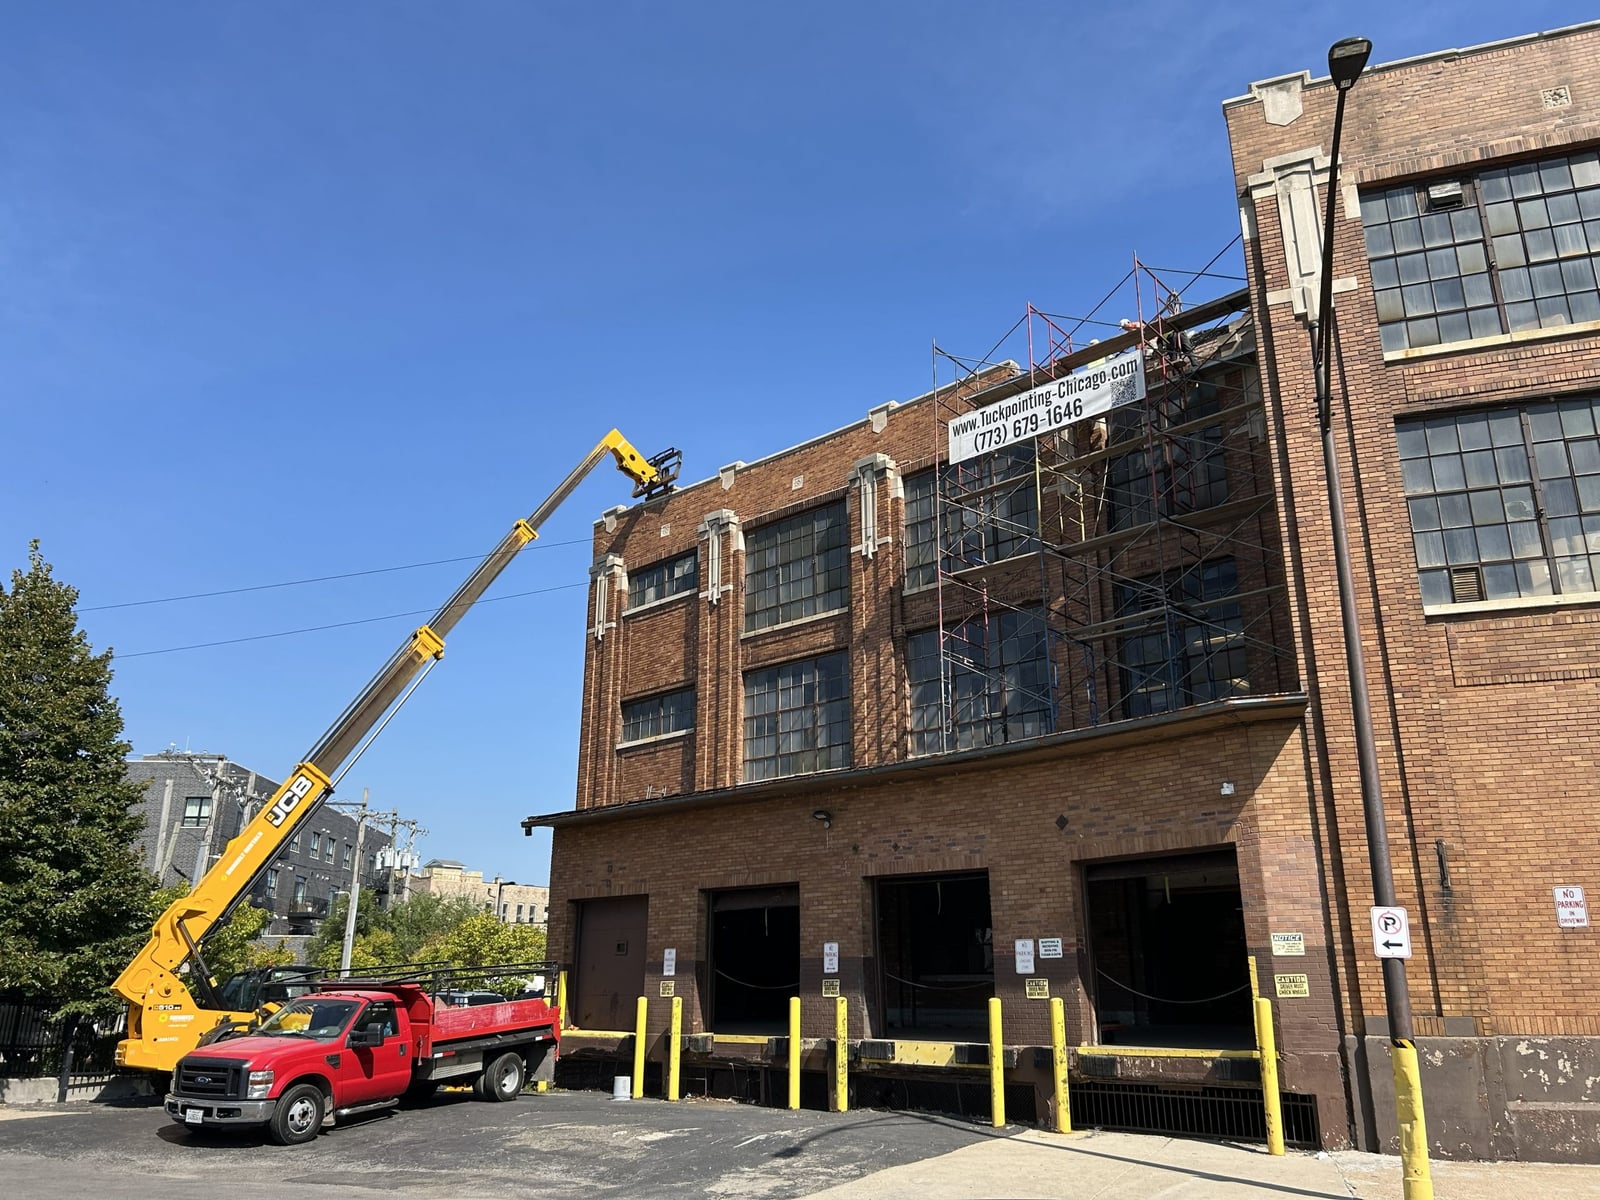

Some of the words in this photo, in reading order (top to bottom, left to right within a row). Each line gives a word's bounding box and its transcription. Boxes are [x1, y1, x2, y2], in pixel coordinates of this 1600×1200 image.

[952, 359, 1138, 437] www.Tuckpointing-Chicago.com
[974, 425, 1008, 452] (773)
[1013, 398, 1083, 438] 679-1646
[271, 775, 313, 826] JCB
[1557, 900, 1584, 908] PARKING
[1563, 890, 1575, 898] NO
